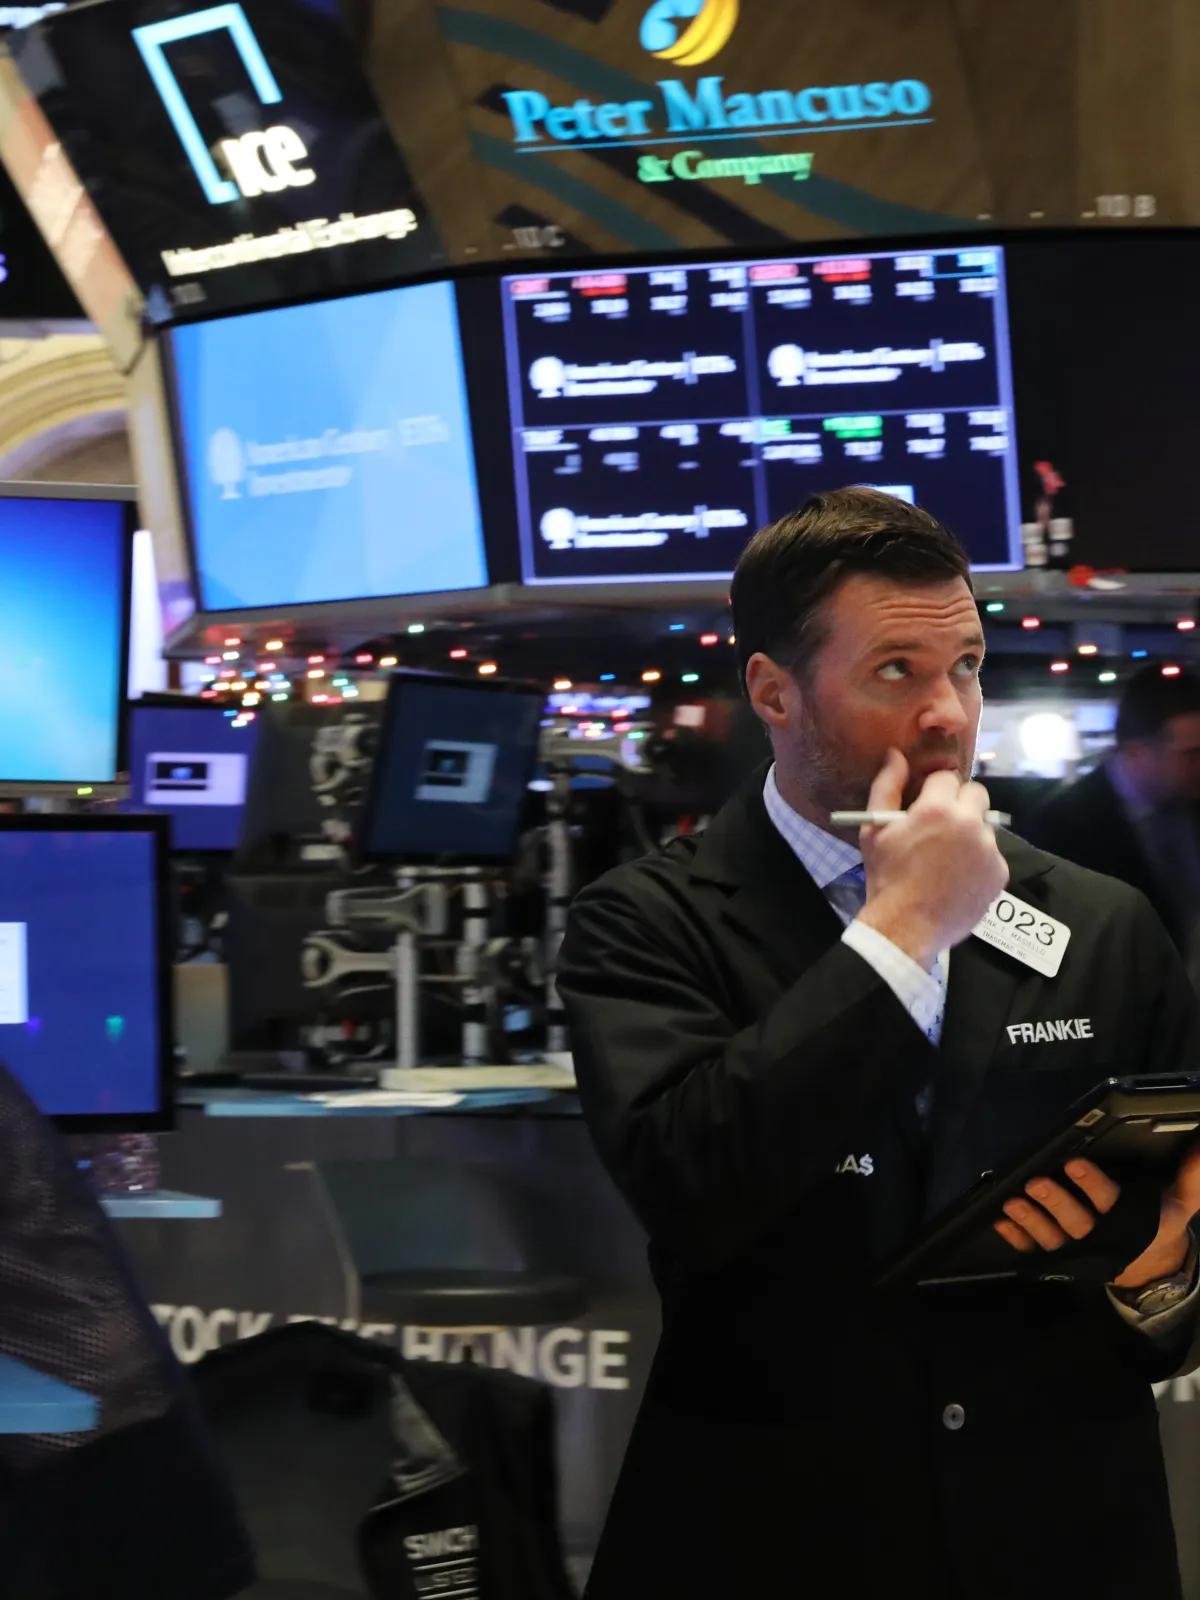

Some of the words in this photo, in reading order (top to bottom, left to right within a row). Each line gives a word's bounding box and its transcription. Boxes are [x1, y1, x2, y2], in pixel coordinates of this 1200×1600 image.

[501, 90, 653, 143] Peter
[657, 76, 932, 133] Mancuso
[638, 155, 674, 183] &
[672, 150, 815, 186] Company
[988, 899, 1056, 946] 023
[1006, 1018, 1094, 1044] FRANKIE
[835, 1153, 874, 1176] A$
